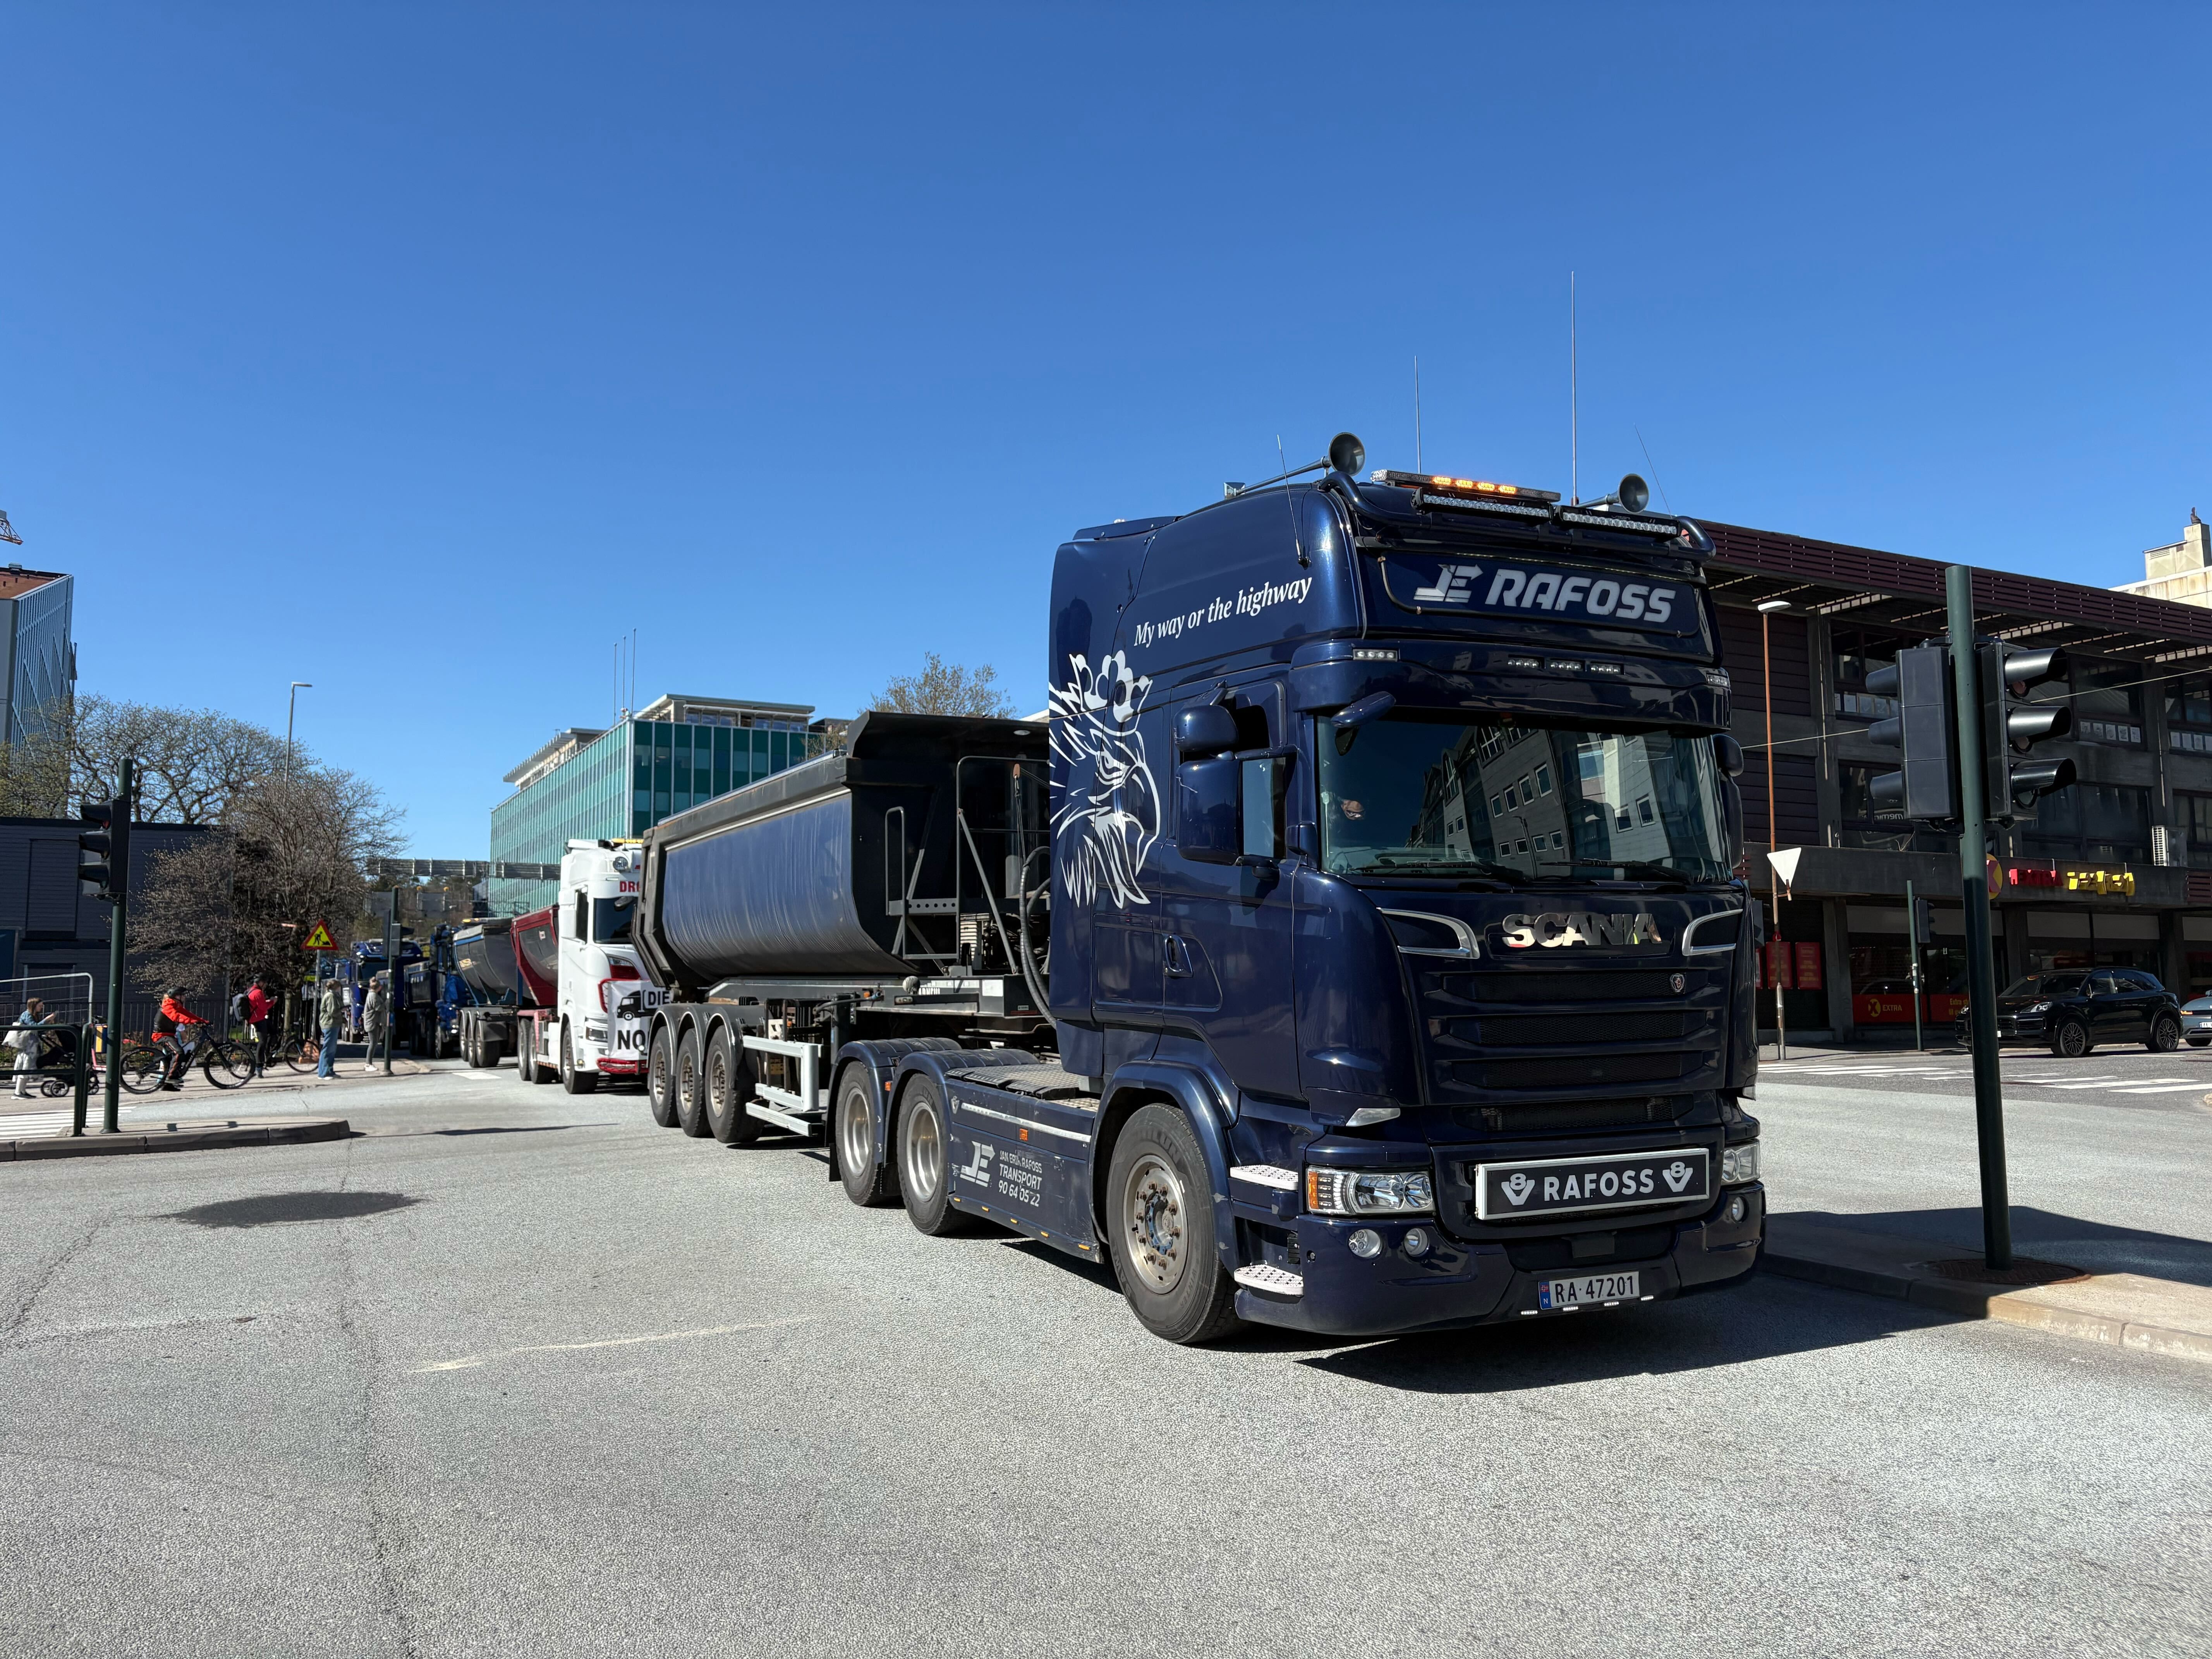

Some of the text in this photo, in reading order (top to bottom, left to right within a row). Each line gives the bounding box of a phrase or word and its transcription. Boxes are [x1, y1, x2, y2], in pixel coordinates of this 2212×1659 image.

[1485, 568, 1677, 623] RAFOSS
[1134, 577, 1312, 648] My way or the highway
[1503, 913, 1662, 948] SCANIA
[1000, 1150, 1008, 1162] JAN
[1022, 1158, 1042, 1173] RAFOSS
[1000, 1163, 1042, 1190] TRANSPORT
[999, 1180, 1008, 1194] 90
[1009, 1184, 1018, 1199] 64
[1544, 1169, 1654, 1201] RAFOSS
[1555, 1275, 1634, 1303] RA 47201
